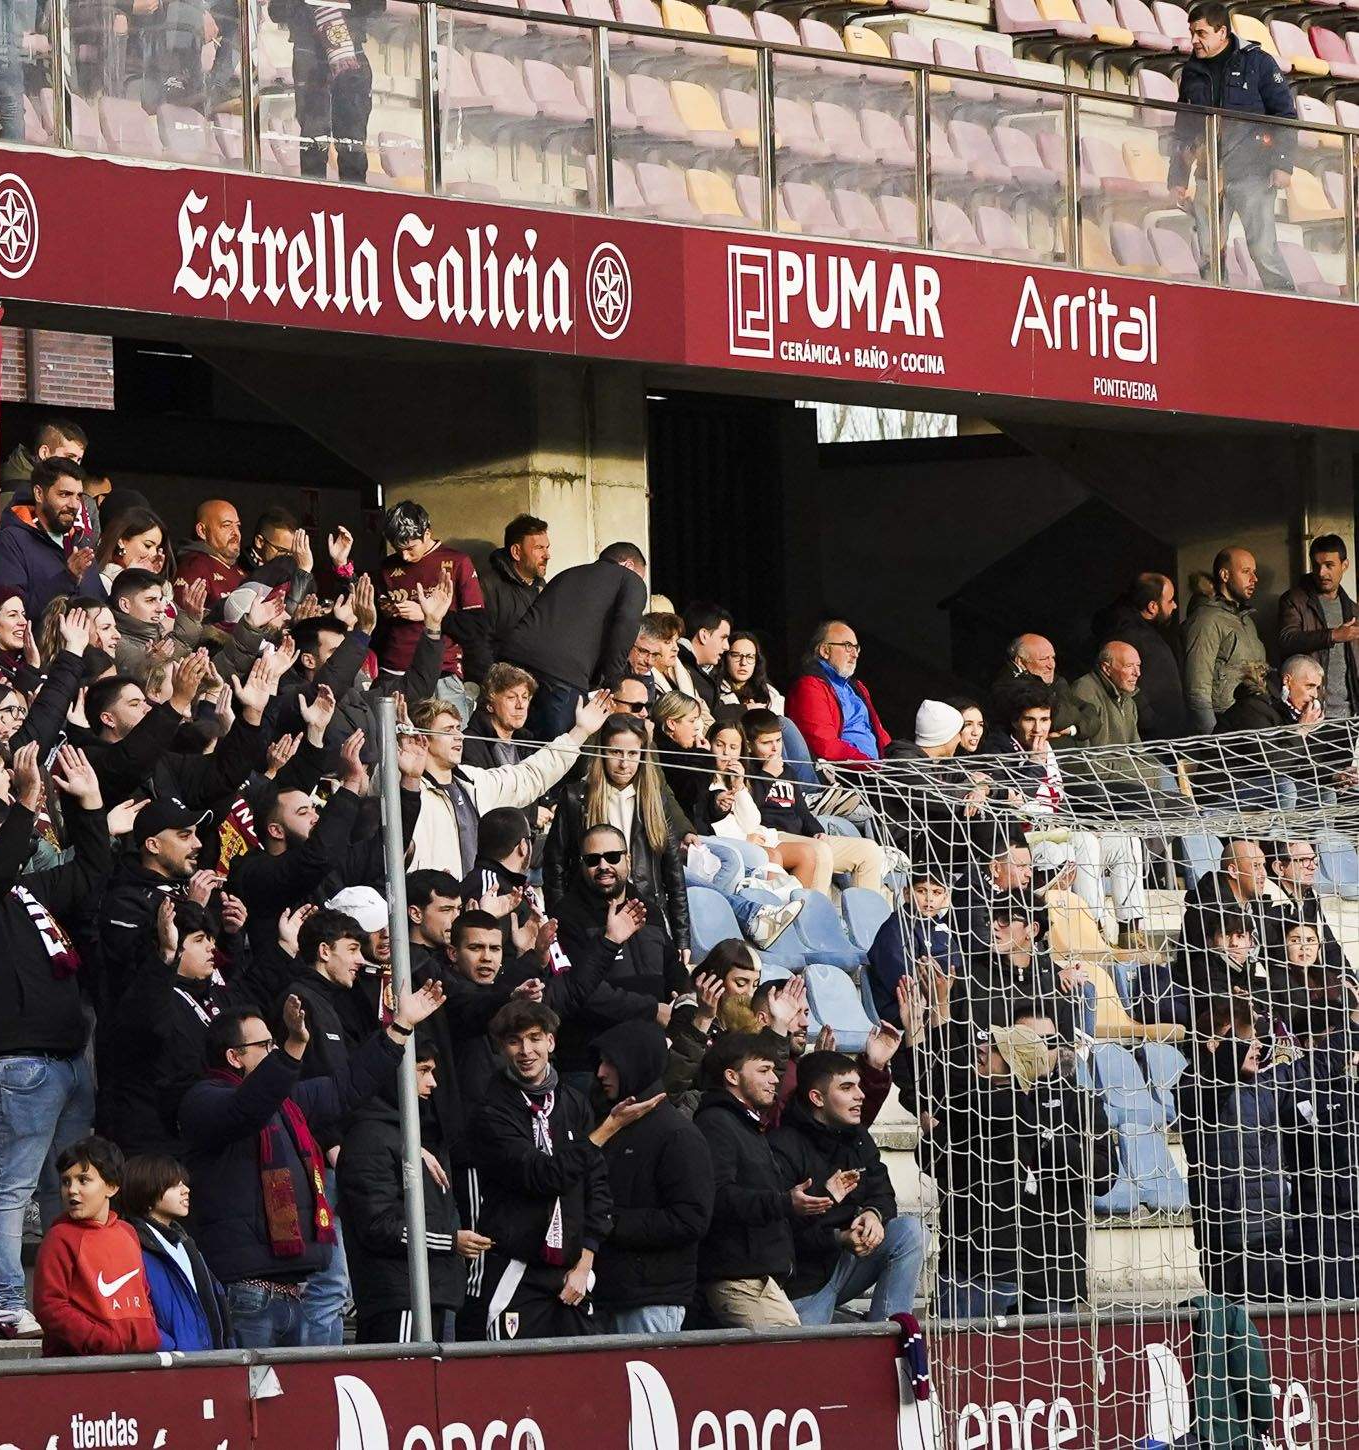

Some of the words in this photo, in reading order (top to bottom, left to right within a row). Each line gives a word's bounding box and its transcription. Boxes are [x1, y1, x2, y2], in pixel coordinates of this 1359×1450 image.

[173, 189, 383, 317] Estrella
[393, 212, 574, 335] Galicia
[777, 250, 944, 338] PUMAR
[1010, 276, 1158, 363] Arrital
[779, 340, 842, 367] CERÁMICA
[854, 345, 889, 370] BAÑO
[900, 352, 945, 375] COCINA
[1093, 377, 1158, 402] PONTEVEDRA
[112, 1295, 141, 1310] AIR
[71, 1411, 139, 1449] tiendas
